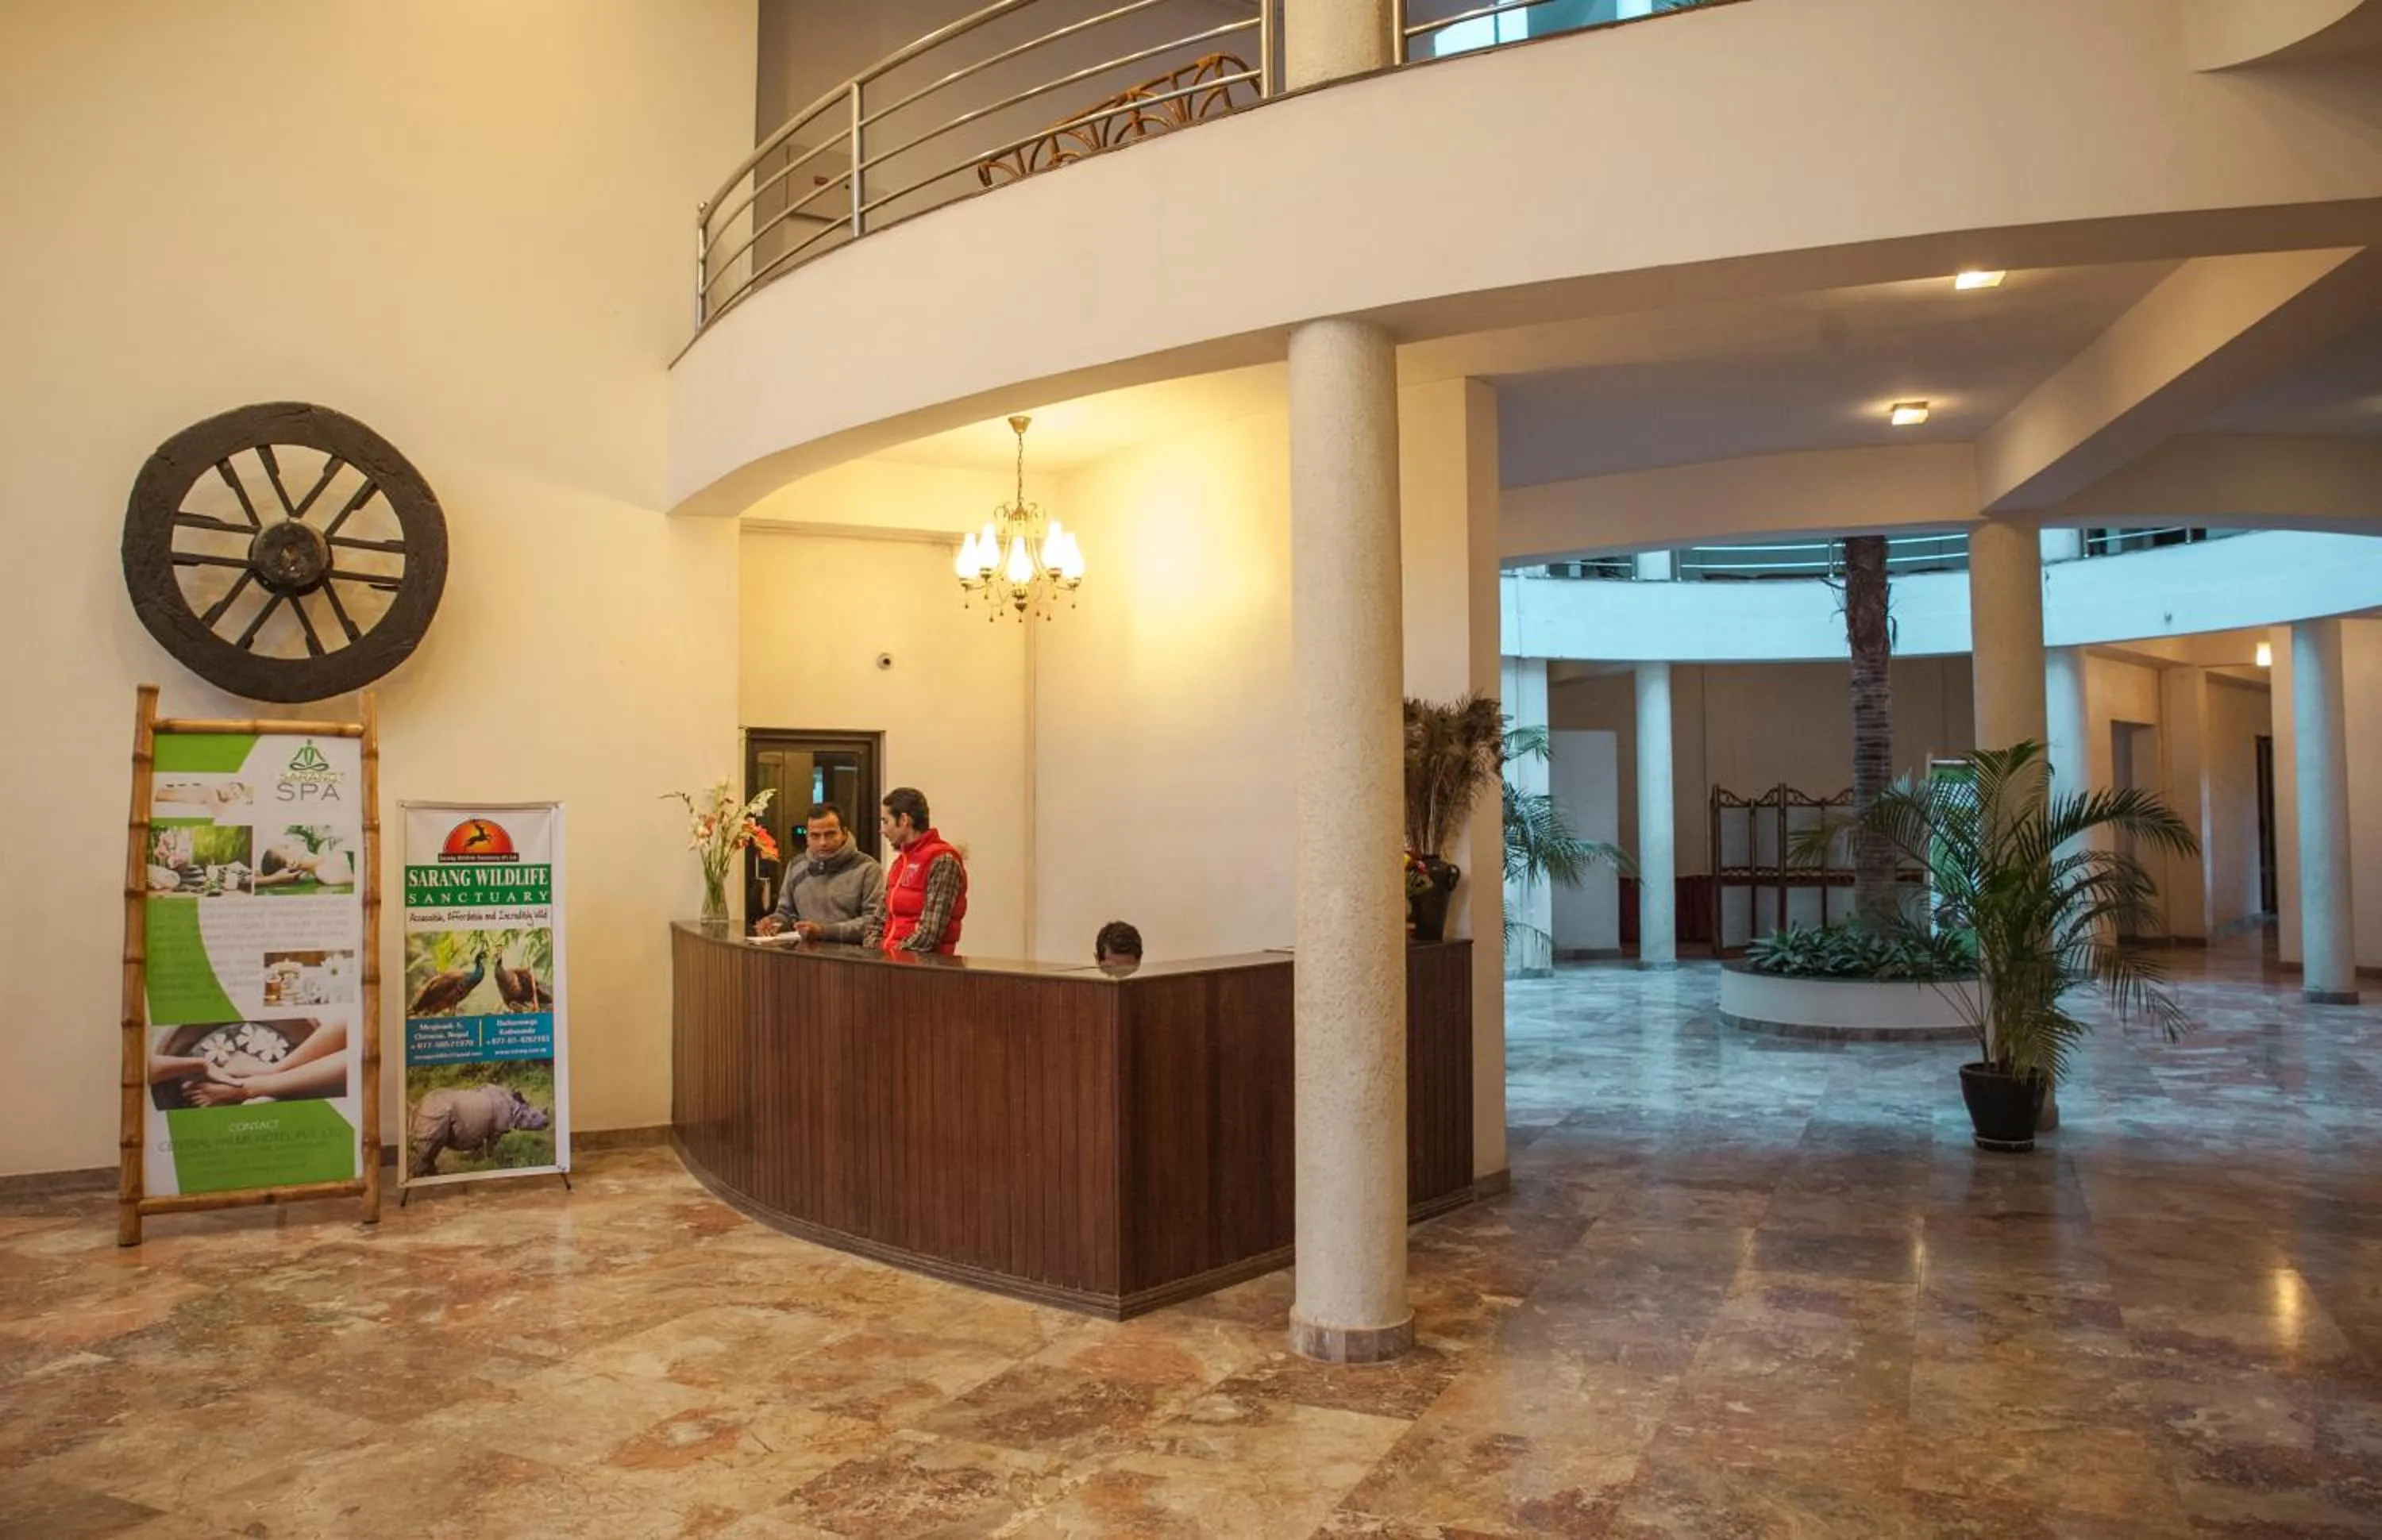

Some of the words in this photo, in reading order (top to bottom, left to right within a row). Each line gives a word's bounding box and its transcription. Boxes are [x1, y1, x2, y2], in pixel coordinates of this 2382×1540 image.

[276, 782, 341, 801] SPA
[408, 869, 471, 887] SARANG
[476, 868, 549, 886] WILDLIFE
[408, 891, 549, 905] SANCTUARY
[227, 1119, 279, 1131] CONTACT
